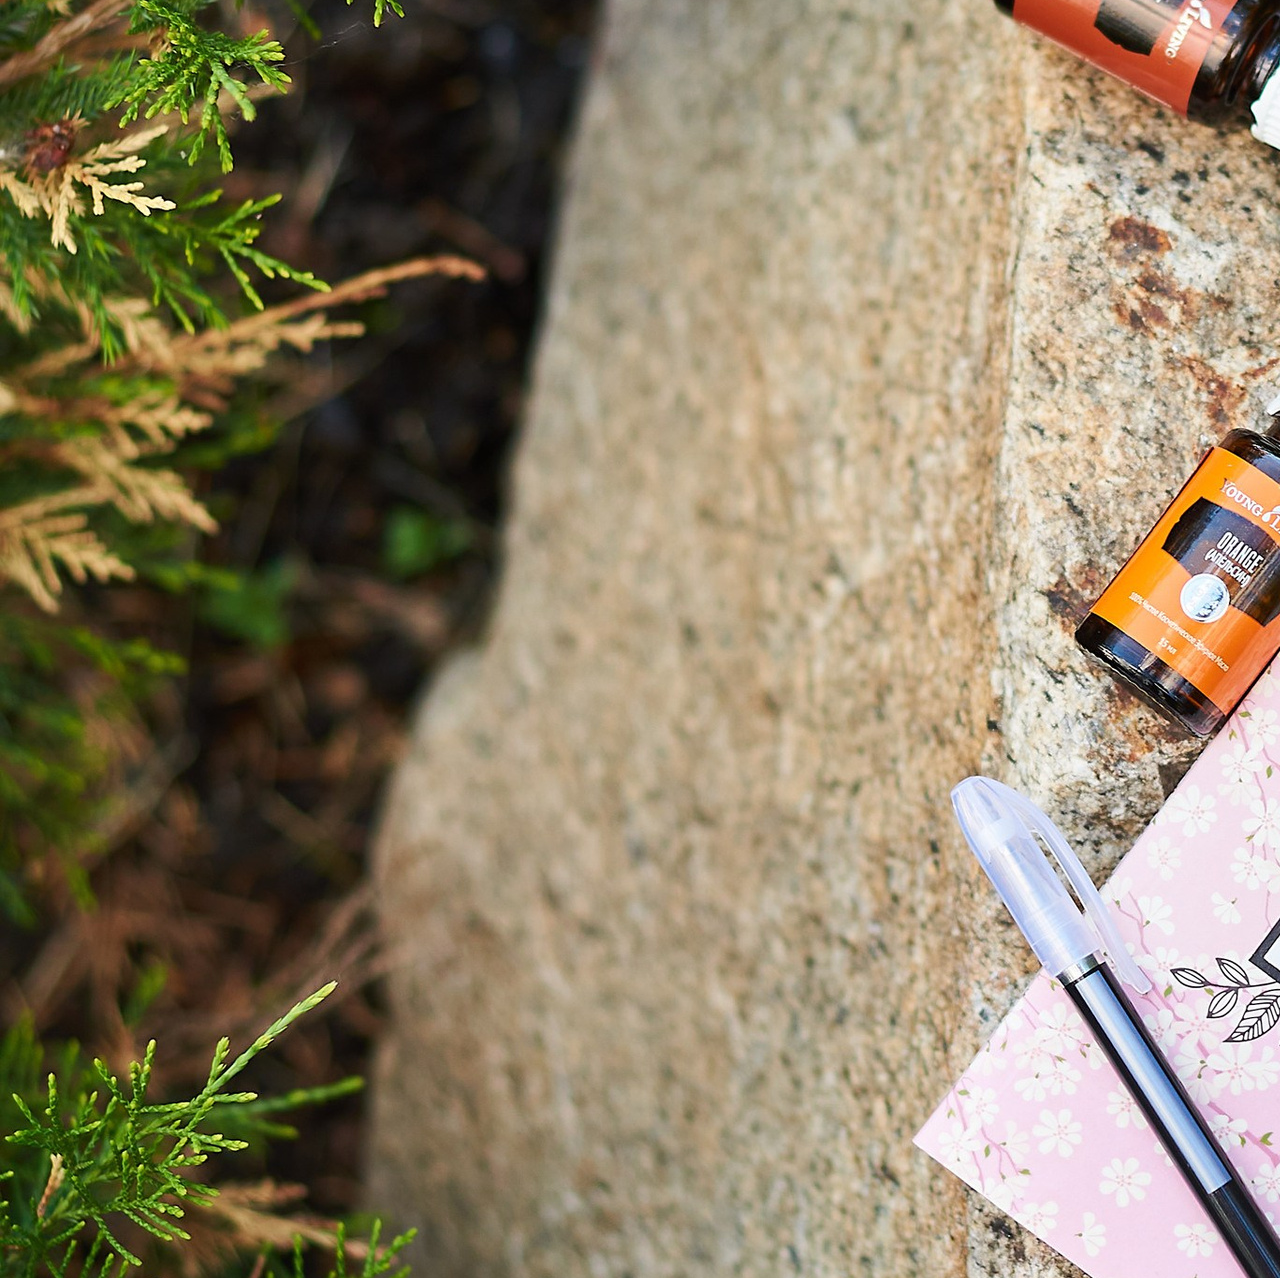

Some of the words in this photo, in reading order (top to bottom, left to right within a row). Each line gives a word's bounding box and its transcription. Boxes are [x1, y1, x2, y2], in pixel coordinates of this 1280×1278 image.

[1164, 7, 1200, 58] LIVING
[1220, 478, 1264, 516] YOUNG
[1204, 548, 1251, 588] (АПЕЛЬСИН)
[1217, 532, 1264, 573] ORANGE
[1158, 637, 1169, 648] 15
